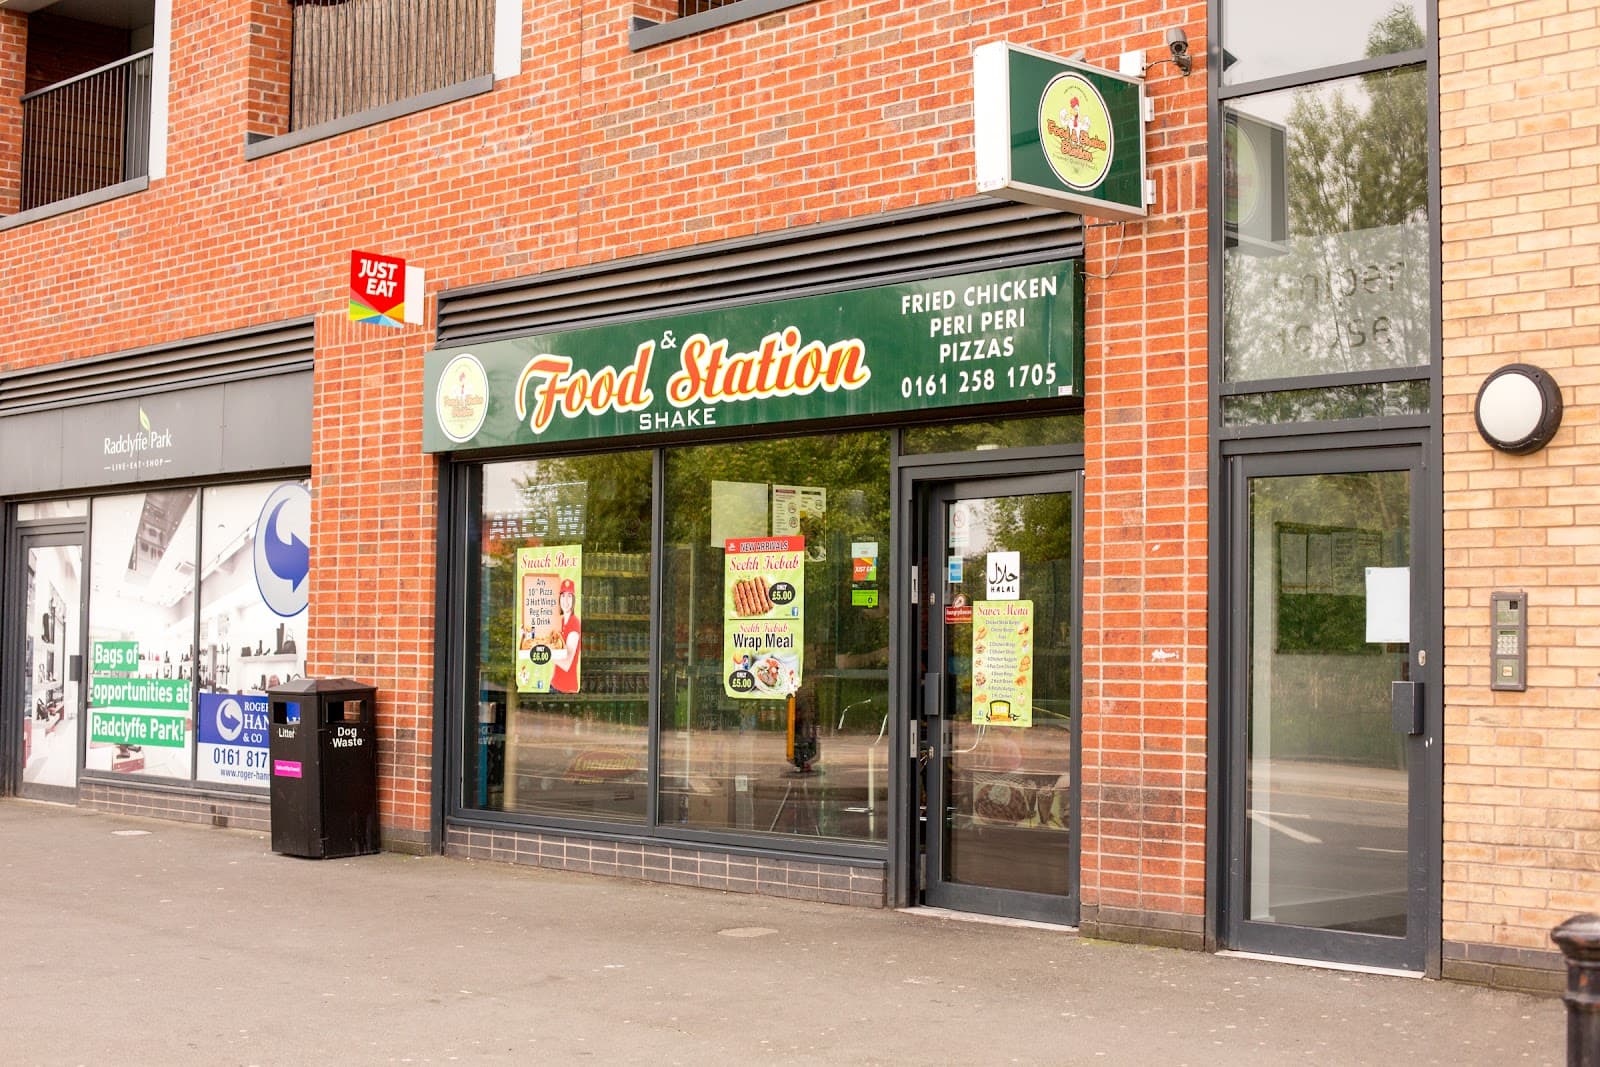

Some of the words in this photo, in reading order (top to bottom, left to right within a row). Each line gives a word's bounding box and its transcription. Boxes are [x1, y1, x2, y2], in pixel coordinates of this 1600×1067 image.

[358, 258, 398, 280] JUST
[366, 278, 398, 298] EAT
[902, 290, 956, 315] FRIED
[963, 275, 1057, 307] CHICKEN
[930, 314, 972, 338] PERI
[981, 307, 1025, 332] PERI
[660, 330, 677, 349] &
[939, 336, 1015, 363] PIZZAS
[515, 339, 654, 434] Food
[666, 326, 871, 408] Station
[901, 373, 947, 398] 0161
[959, 368, 995, 393] 258
[1007, 362, 1057, 388] 1705
[639, 407, 716, 430] SHAKE
[104, 432, 147, 457] Radclyffe
[151, 428, 172, 449] Park
[521, 553, 551, 569] Snack
[555, 551, 578, 568] Box
[763, 554, 799, 571] Kebab
[989, 561, 1018, 585] حلال
[539, 587, 553, 596] Pizza
[772, 590, 793, 601] £5.00
[530, 598, 540, 606] Hot
[541, 598, 557, 607] Wings
[540, 608, 553, 616] Fries
[1003, 603, 1029, 616] Menu
[537, 617, 551, 625] Drink
[733, 633, 762, 651] Wrap
[765, 633, 794, 648] Meal
[95, 644, 123, 669] Bags
[126, 644, 139, 665] of
[732, 678, 752, 688] £5.00
[93, 681, 173, 705] opportunities
[175, 682, 189, 704] at
[93, 715, 147, 742] Radclyffe
[150, 718, 184, 742] Park!
[243, 733, 250, 743] &
[251, 733, 262, 743] CO
[278, 727, 295, 739] Litter
[337, 726, 357, 738] Dog
[332, 737, 363, 748] Waste
[213, 747, 240, 765] 0161
[246, 750, 268, 768] 817
